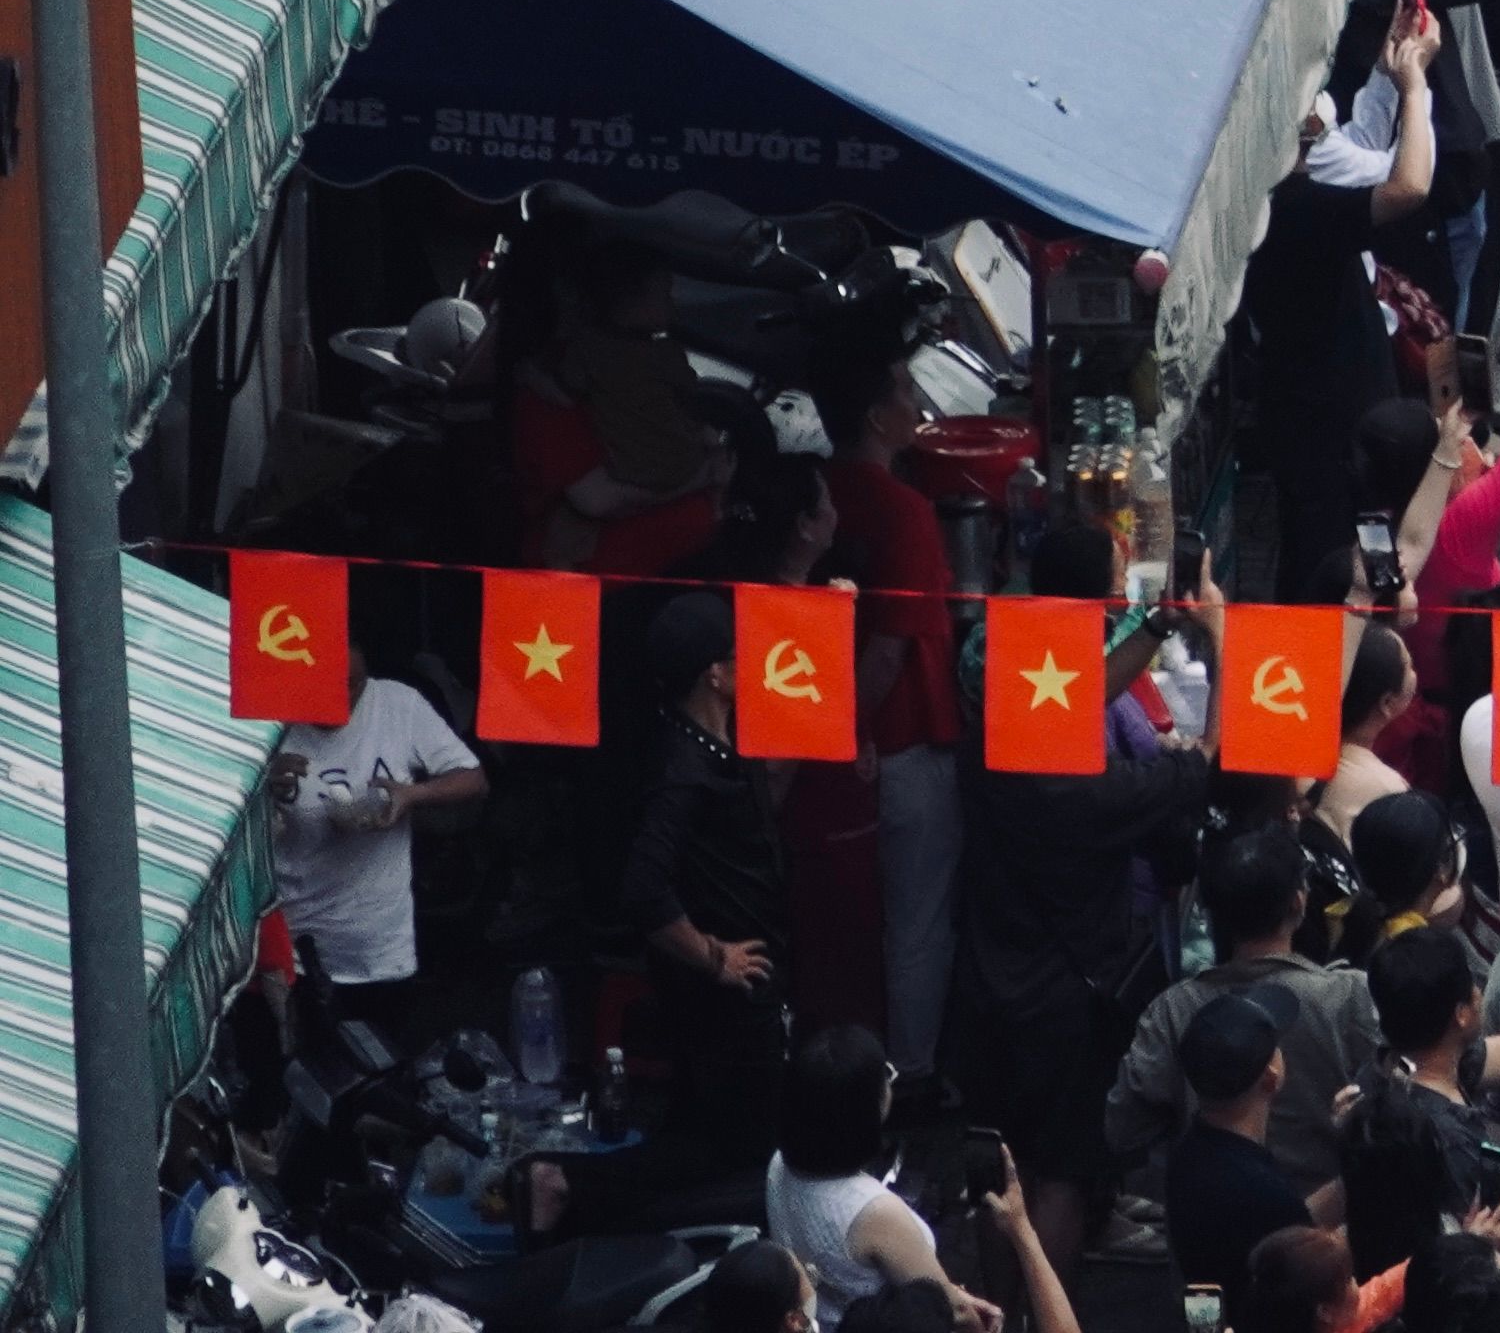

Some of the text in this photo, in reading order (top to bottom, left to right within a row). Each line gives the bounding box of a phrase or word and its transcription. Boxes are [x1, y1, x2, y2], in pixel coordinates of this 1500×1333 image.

[323, 96, 387, 128] HÊ
[434, 107, 557, 142] SINH
[570, 113, 634, 149] TỐ
[683, 127, 823, 165] NƯỚC
[836, 135, 901, 171] ÉP
